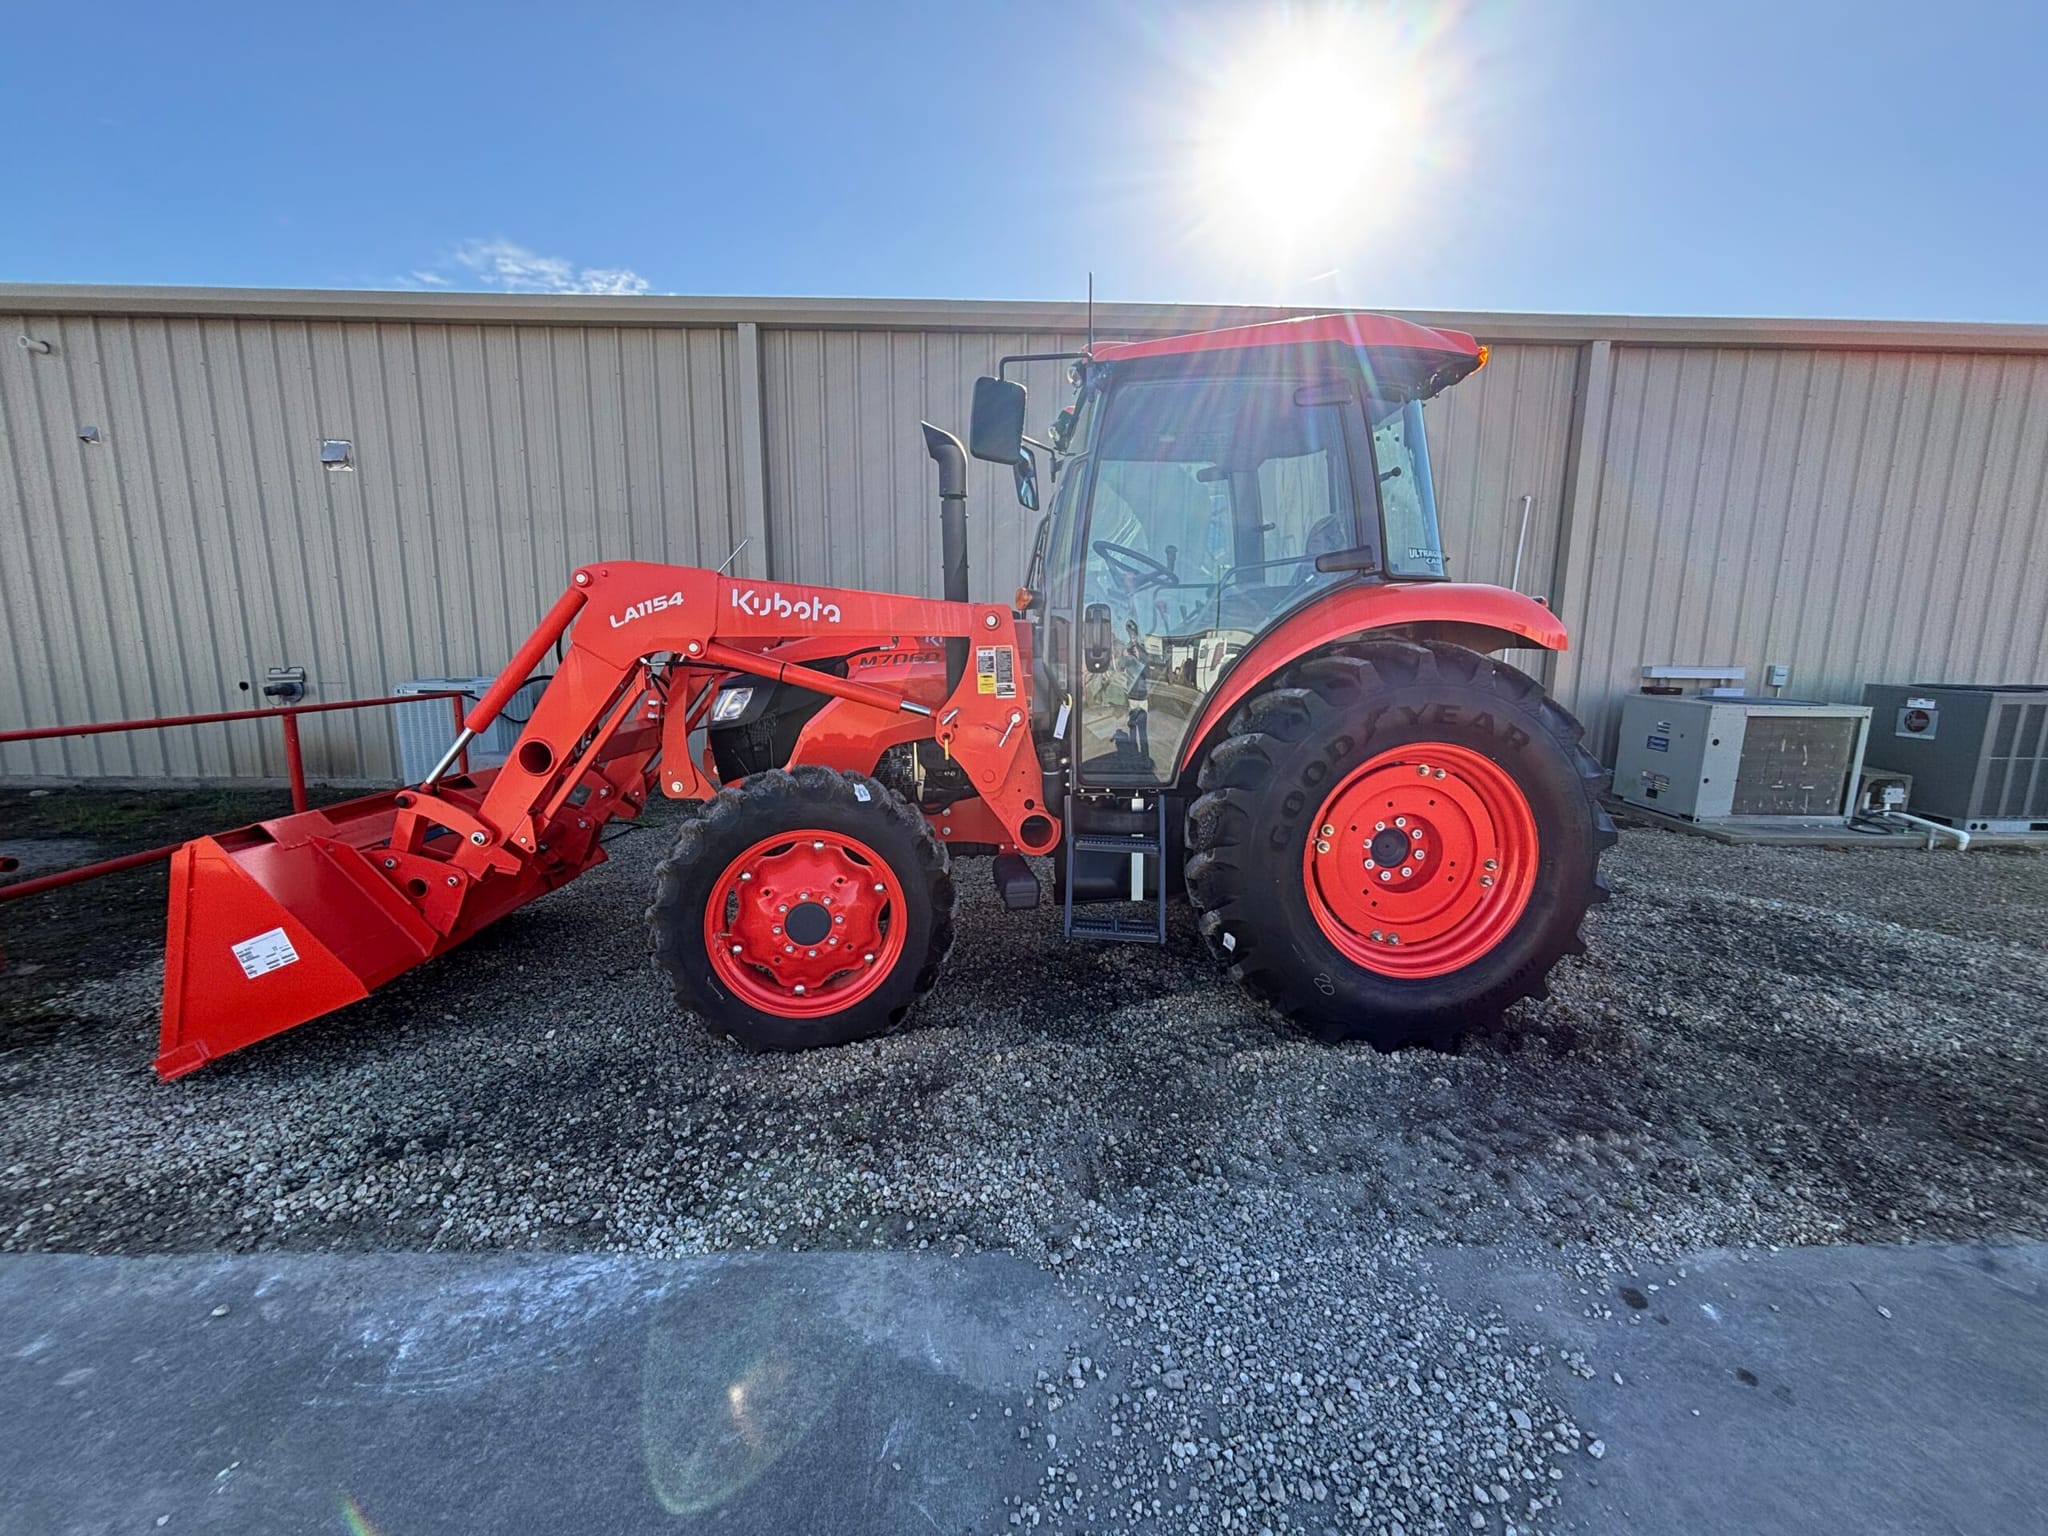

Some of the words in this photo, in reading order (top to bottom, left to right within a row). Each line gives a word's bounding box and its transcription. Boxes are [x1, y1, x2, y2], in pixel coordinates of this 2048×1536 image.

[609, 591, 684, 629] LA1154
[731, 588, 842, 623] Kubota
[859, 651, 940, 668] M7060
